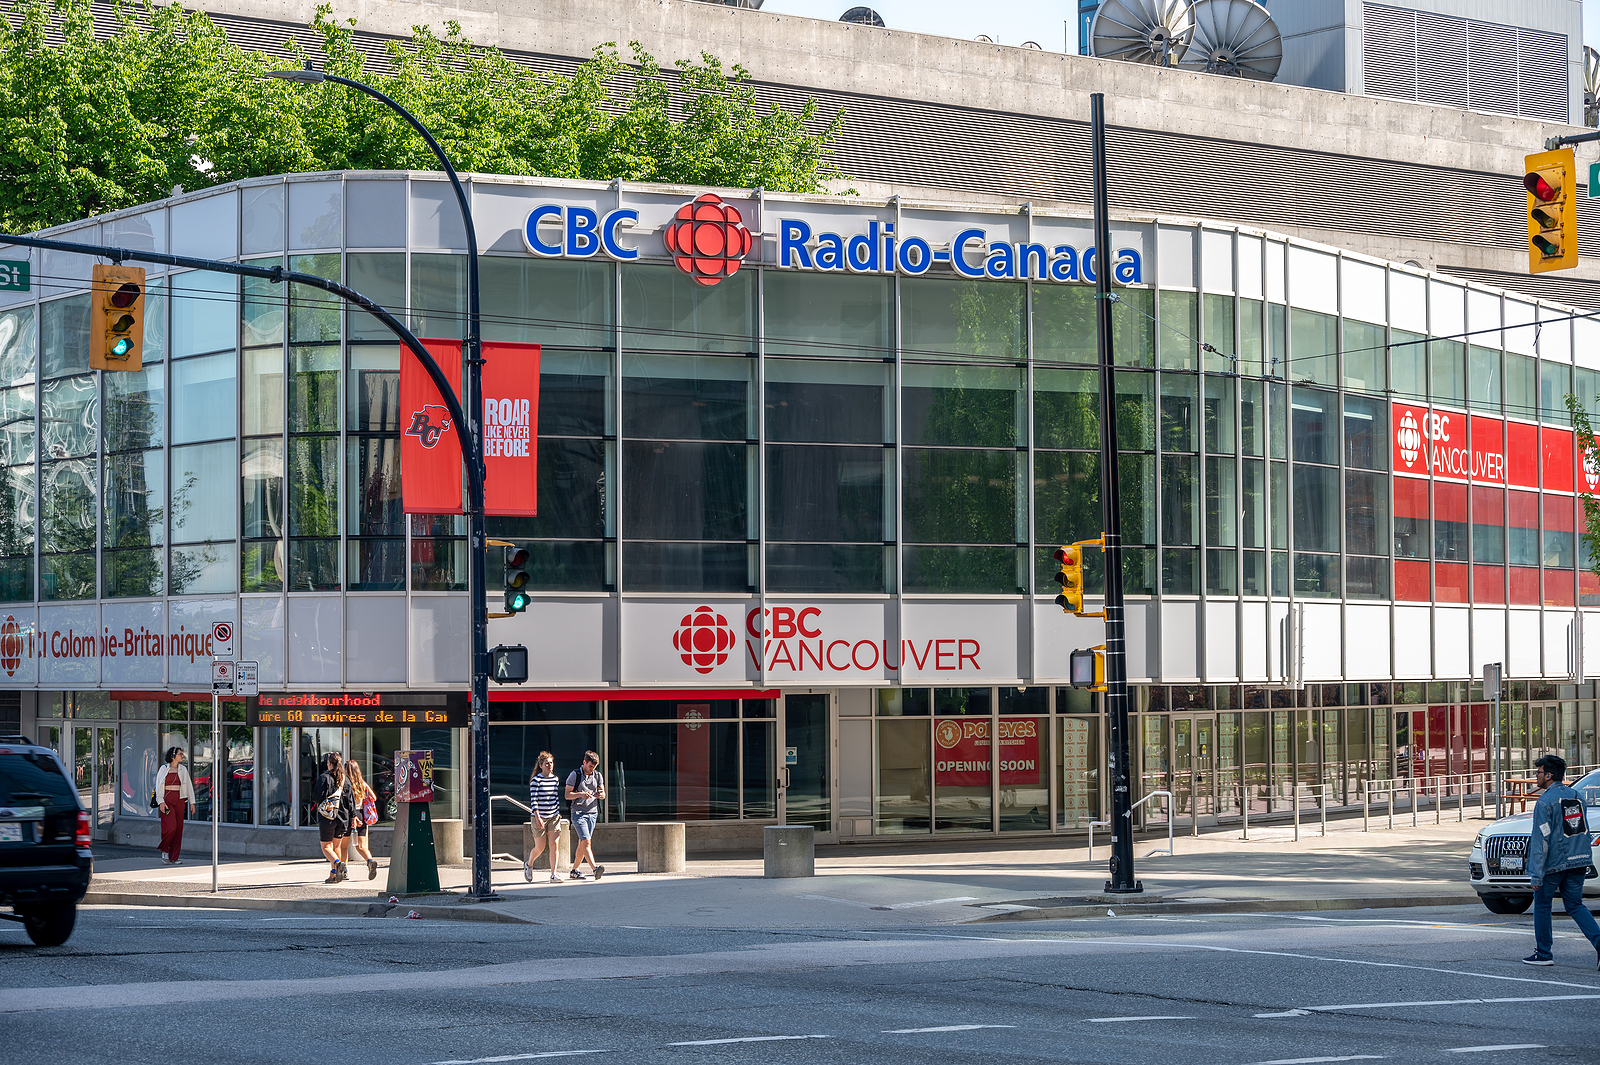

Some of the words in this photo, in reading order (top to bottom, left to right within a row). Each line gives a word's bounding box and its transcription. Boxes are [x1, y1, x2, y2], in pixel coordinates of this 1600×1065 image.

[524, 204, 639, 261] CBC
[0, 264, 20, 286] St
[484, 398, 530, 426] ROAR
[484, 426, 502, 438] LIKE
[504, 426, 530, 439] NEVER
[1422, 412, 1450, 442] CBC
[484, 438, 530, 457] BEFORE
[745, 606, 823, 639] CBC
[745, 639, 982, 672] VANCOUVER
[258, 694, 273, 706] he
[278, 694, 381, 706] neighbourhood
[259, 711, 281, 722] uire
[287, 710, 303, 722] 60
[311, 711, 366, 722] navires
[375, 710, 394, 722] de
[402, 710, 416, 722] la
[1000, 759, 1035, 772] SOON
